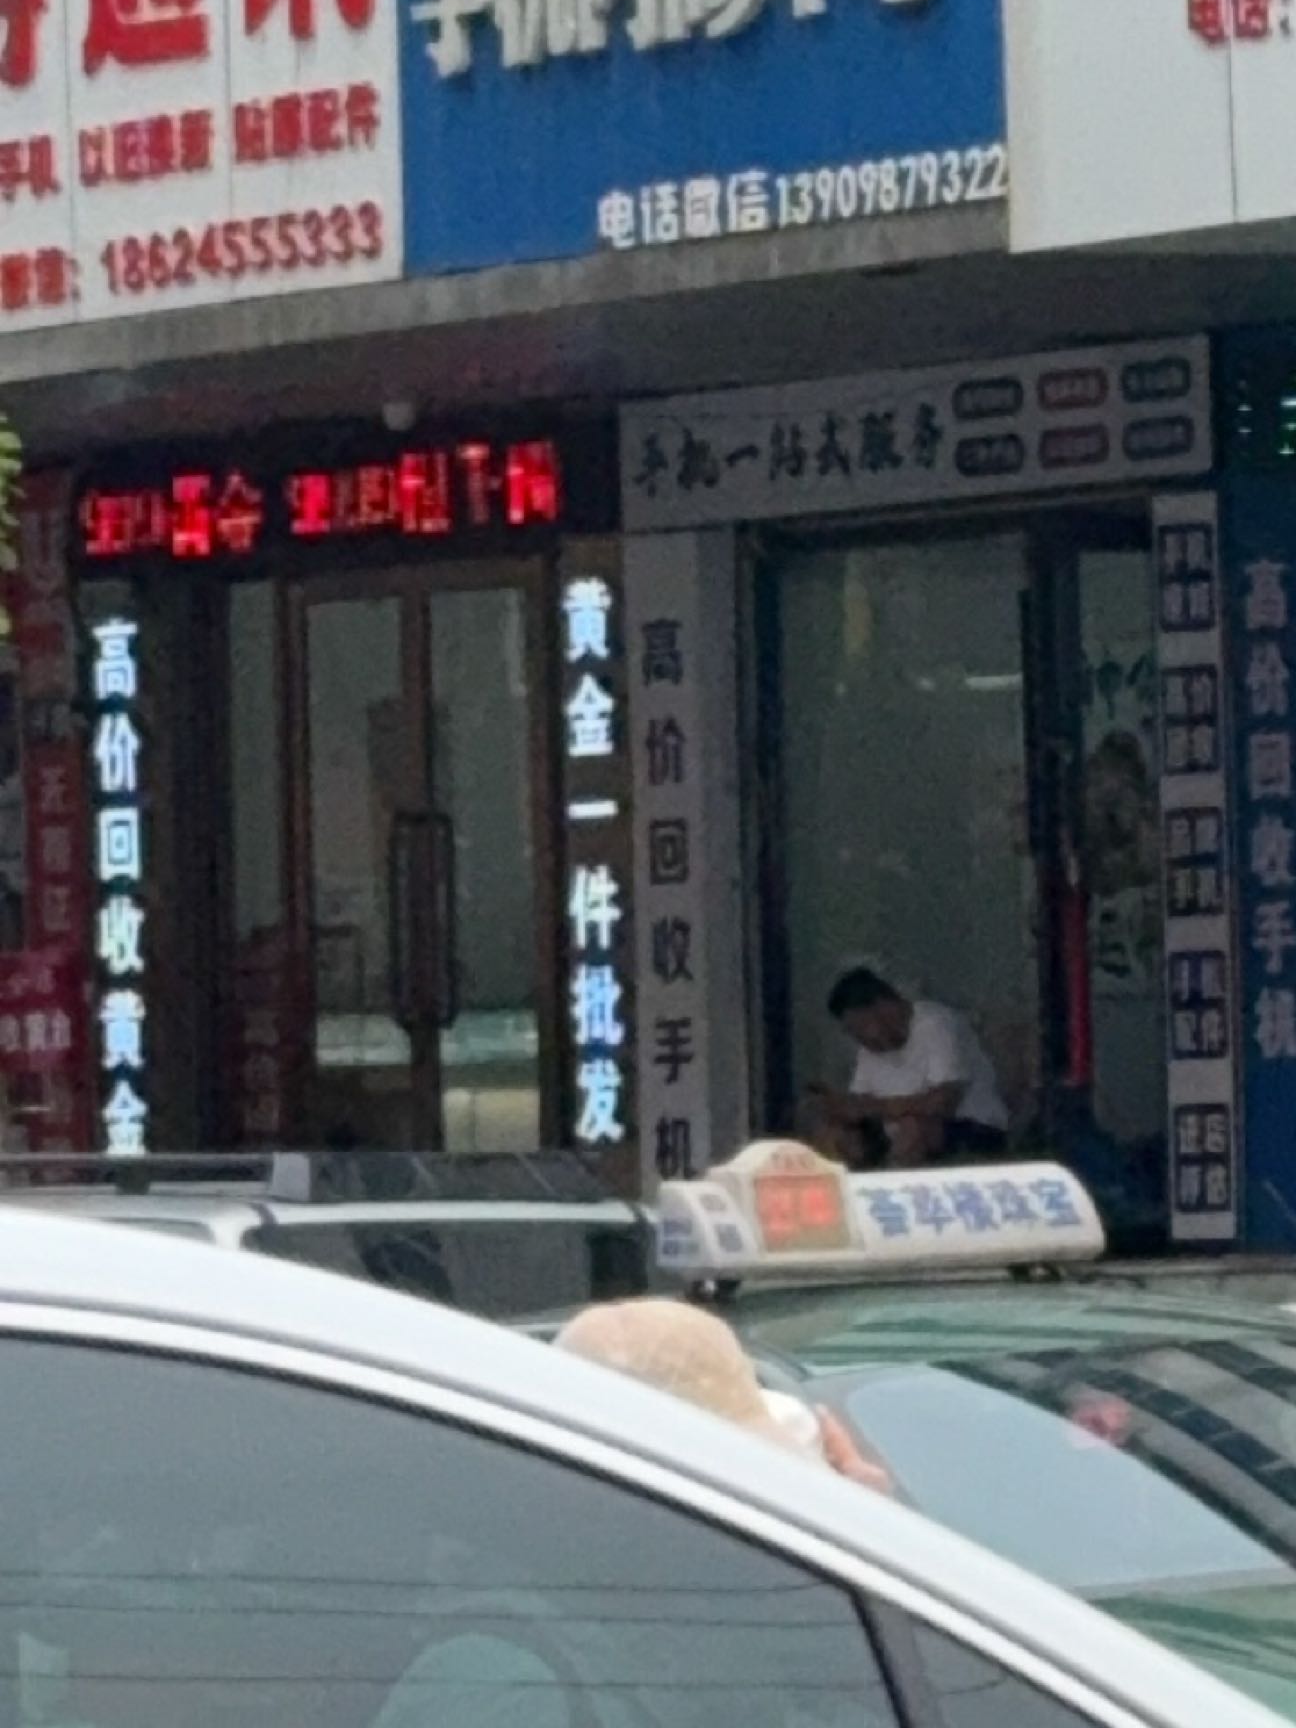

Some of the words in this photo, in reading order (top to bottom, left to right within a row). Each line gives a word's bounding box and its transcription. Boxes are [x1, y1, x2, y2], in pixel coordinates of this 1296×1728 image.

[100, 200, 383, 296] 18624555333
[93, 616, 149, 1158] 高价回收黄金
[563, 576, 624, 1145] 黄金一件批发
[641, 618, 694, 1180] 高价回收手机
